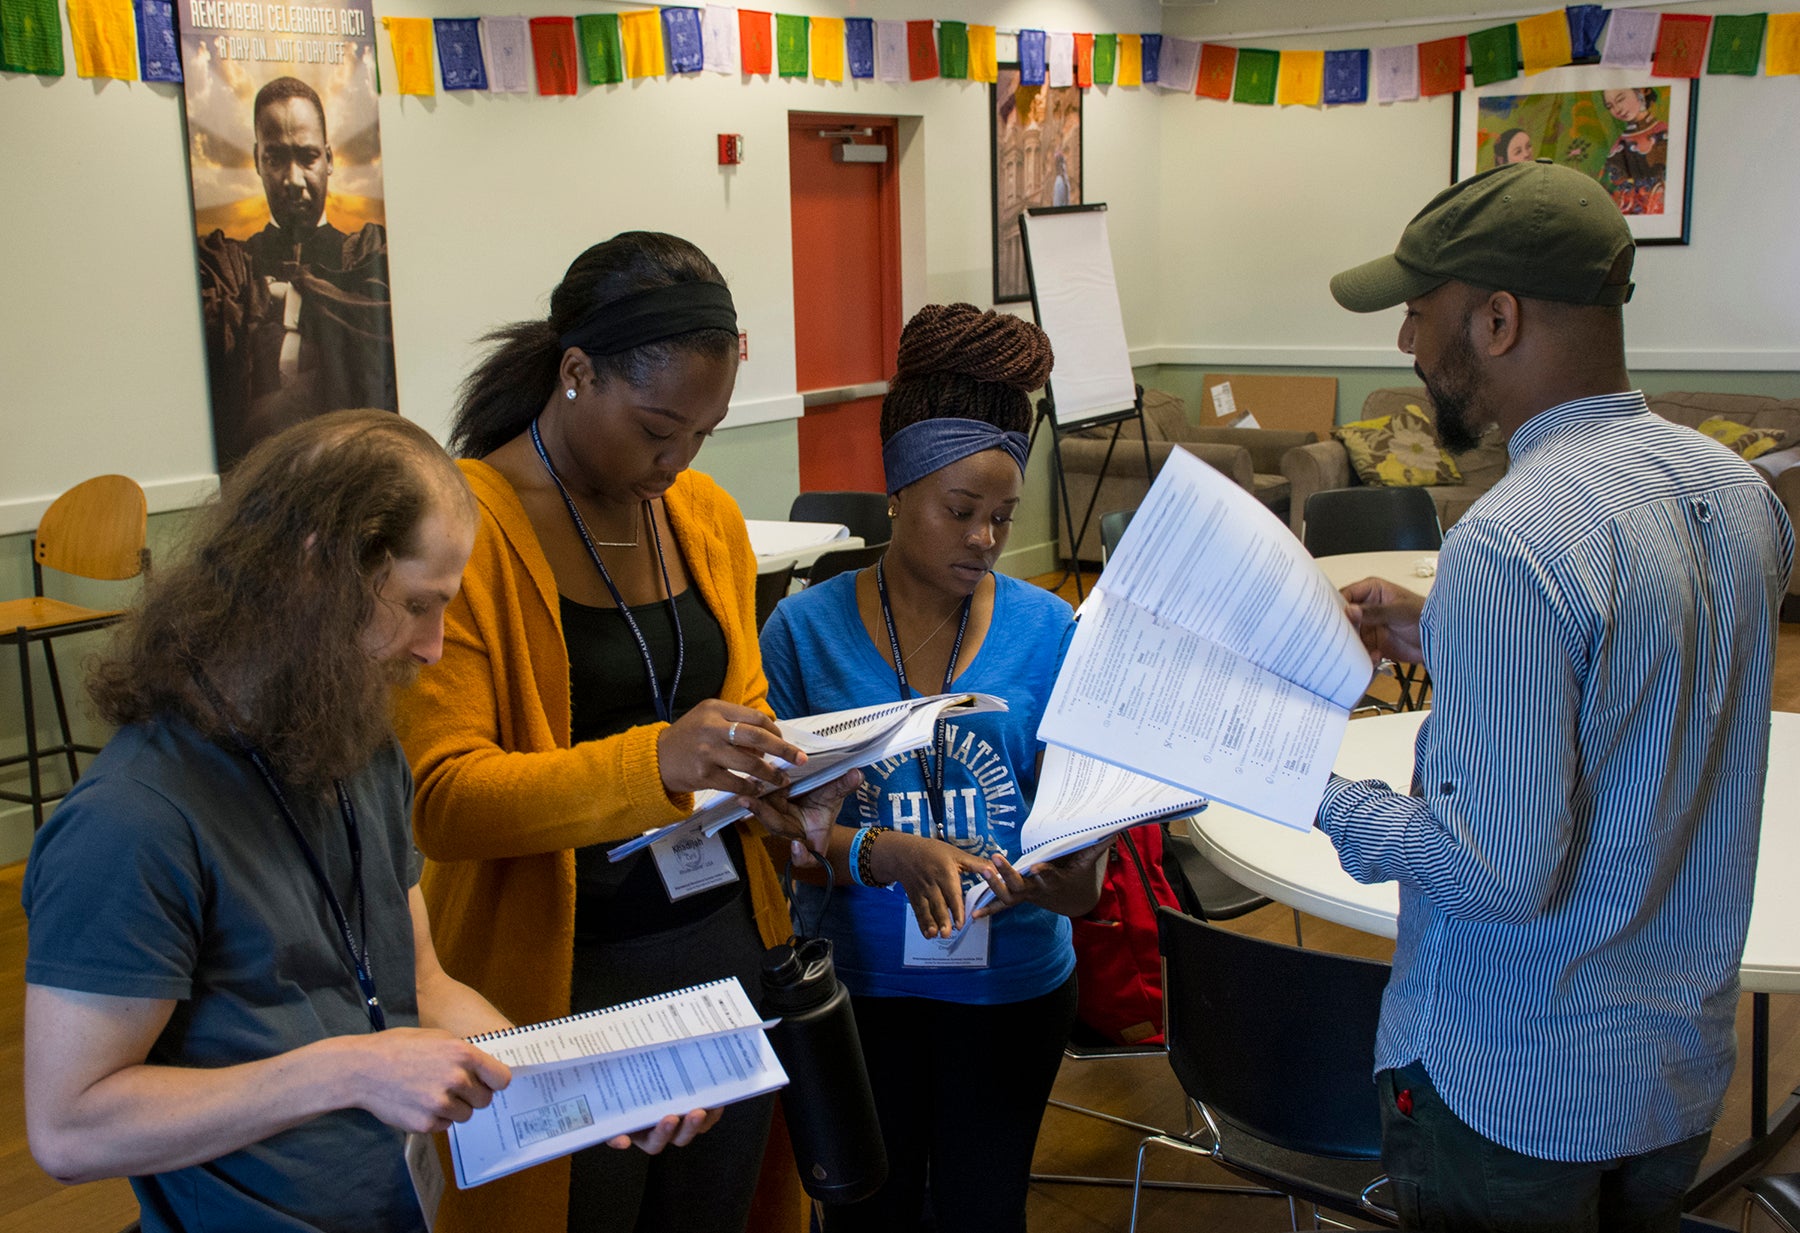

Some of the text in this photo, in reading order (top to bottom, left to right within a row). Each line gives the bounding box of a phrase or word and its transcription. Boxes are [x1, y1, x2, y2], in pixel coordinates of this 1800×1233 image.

[190, 0, 366, 36] REMEMBER! CELEBRATE! ACT!
[218, 36, 227, 58] A
[229, 37, 250, 61] DAY
[296, 41, 305, 62] A
[306, 41, 326, 64] DAY
[328, 43, 345, 65] OFF
